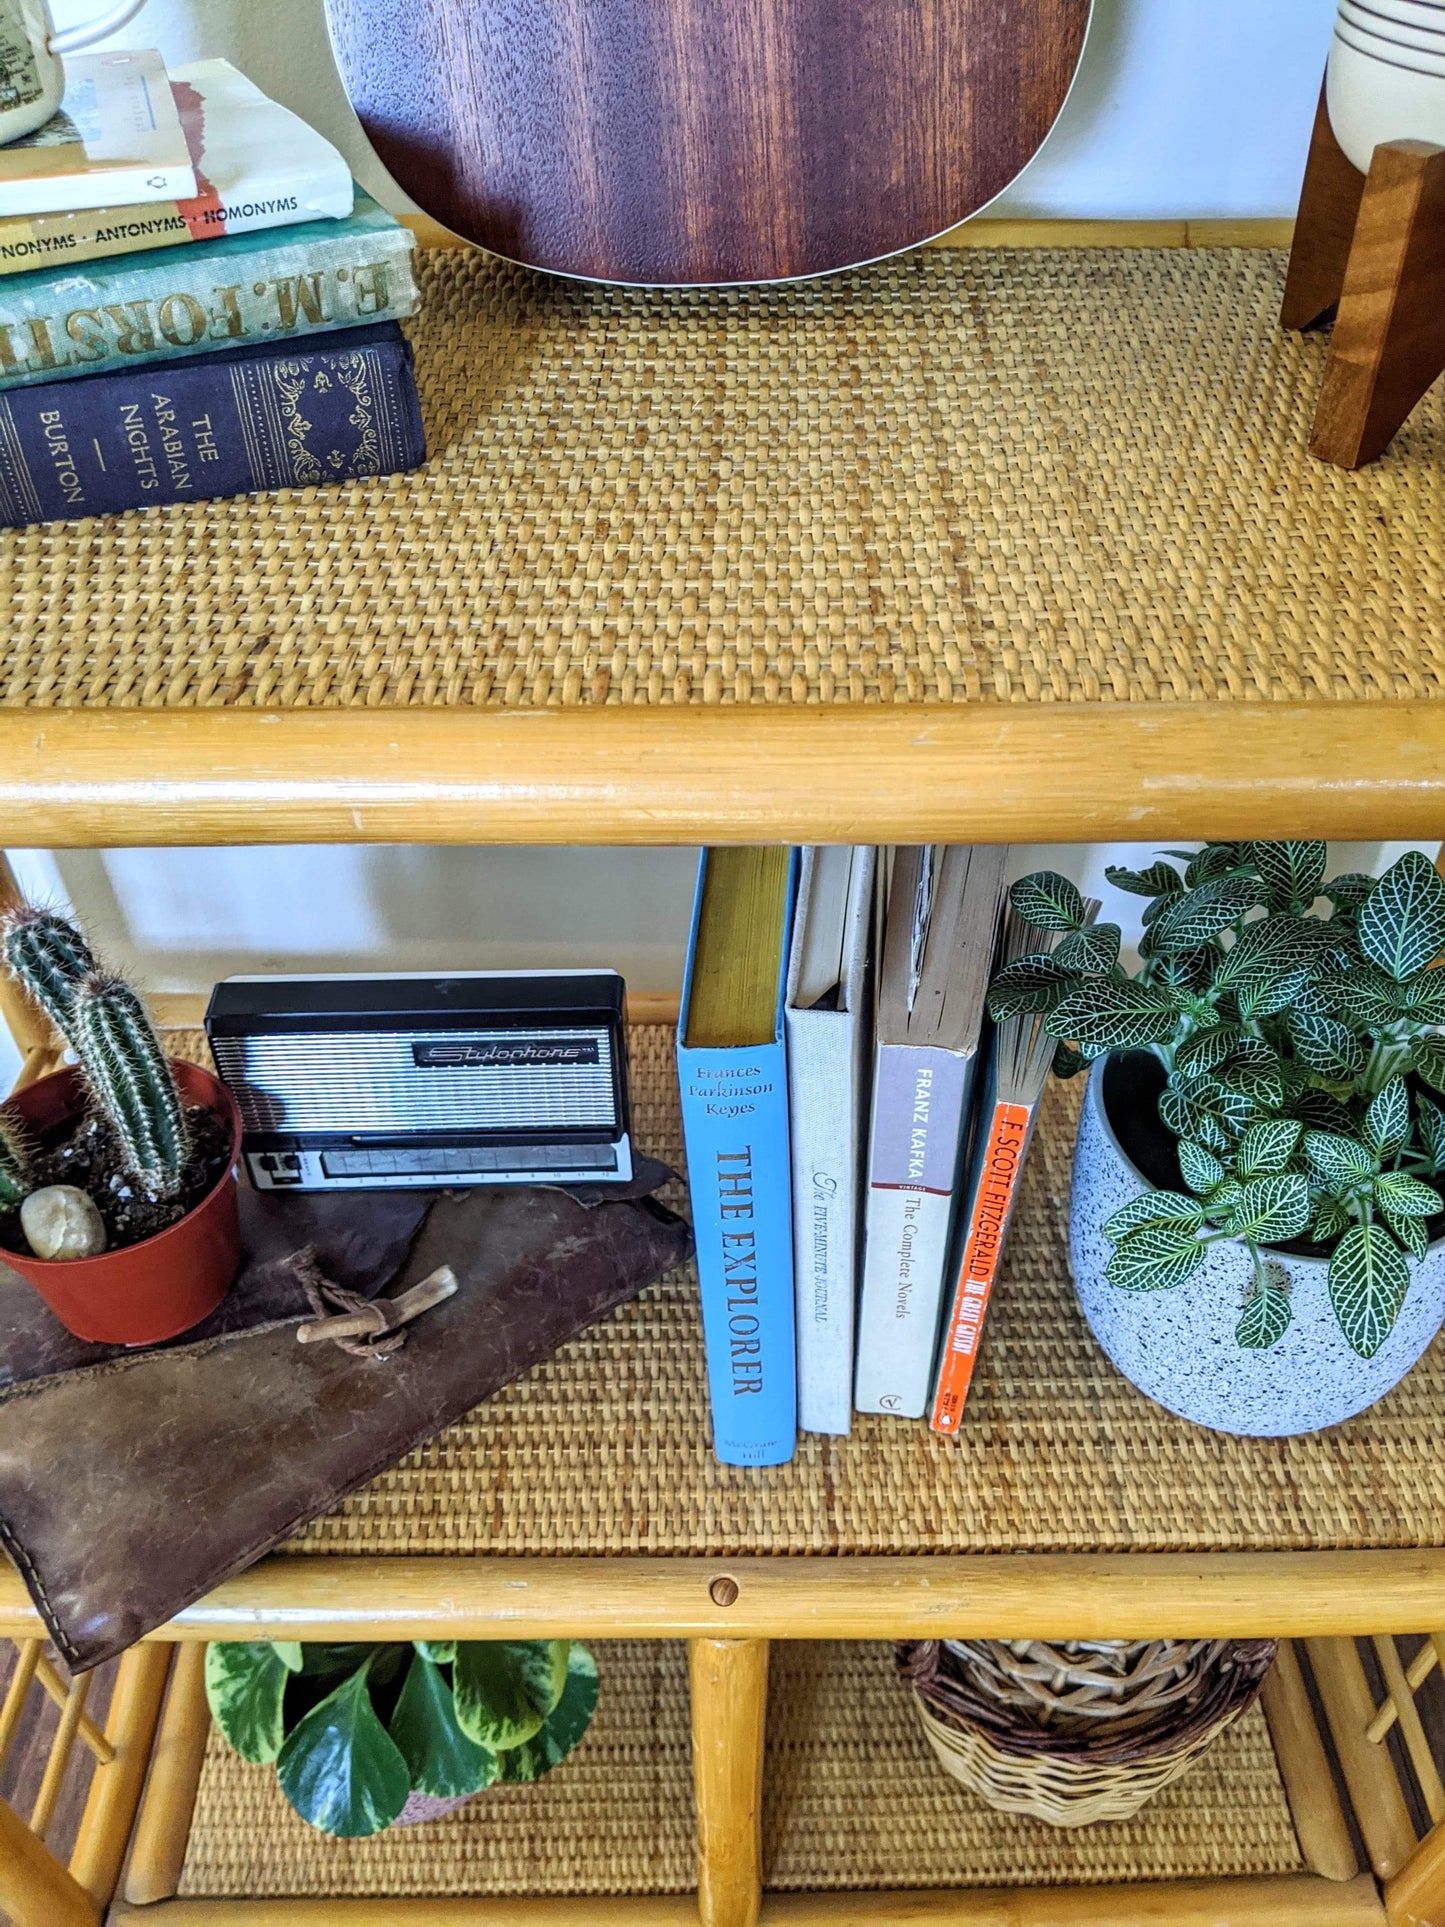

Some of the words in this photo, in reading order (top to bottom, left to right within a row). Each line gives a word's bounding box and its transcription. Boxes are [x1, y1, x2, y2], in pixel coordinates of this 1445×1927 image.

[95, 214, 187, 243] ANTONYMS
[203, 196, 298, 225] HOMONYMS
[39, 410, 86, 504] BURTON
[119, 404, 160, 490] NIGHTS
[151, 393, 193, 490] ARABIAN
[191, 413, 220, 463] THE
[423, 1045, 582, 1063] Stylophone
[696, 1066, 761, 1079] Frances
[688, 1081, 773, 1098] Parkinson
[706, 1103, 756, 1118] Keyes
[912, 1068, 933, 1123] FRANZ
[1000, 1120, 1023, 1132] F.
[908, 1128, 928, 1178] KAFKA
[988, 1136, 1020, 1189] SCOTT
[716, 1145, 754, 1220] THE
[904, 1198, 922, 1220] The
[897, 1224, 919, 1278] Complete
[968, 1191, 1007, 1277] FITZGERALD
[814, 1277, 828, 1323] JOURNAL
[895, 1282, 913, 1320] Novels
[958, 1296, 983, 1324] GREAT
[964, 1278, 988, 1296] THE
[722, 1230, 763, 1396] EXPLORER
[951, 1323, 977, 1355] GATSBY
